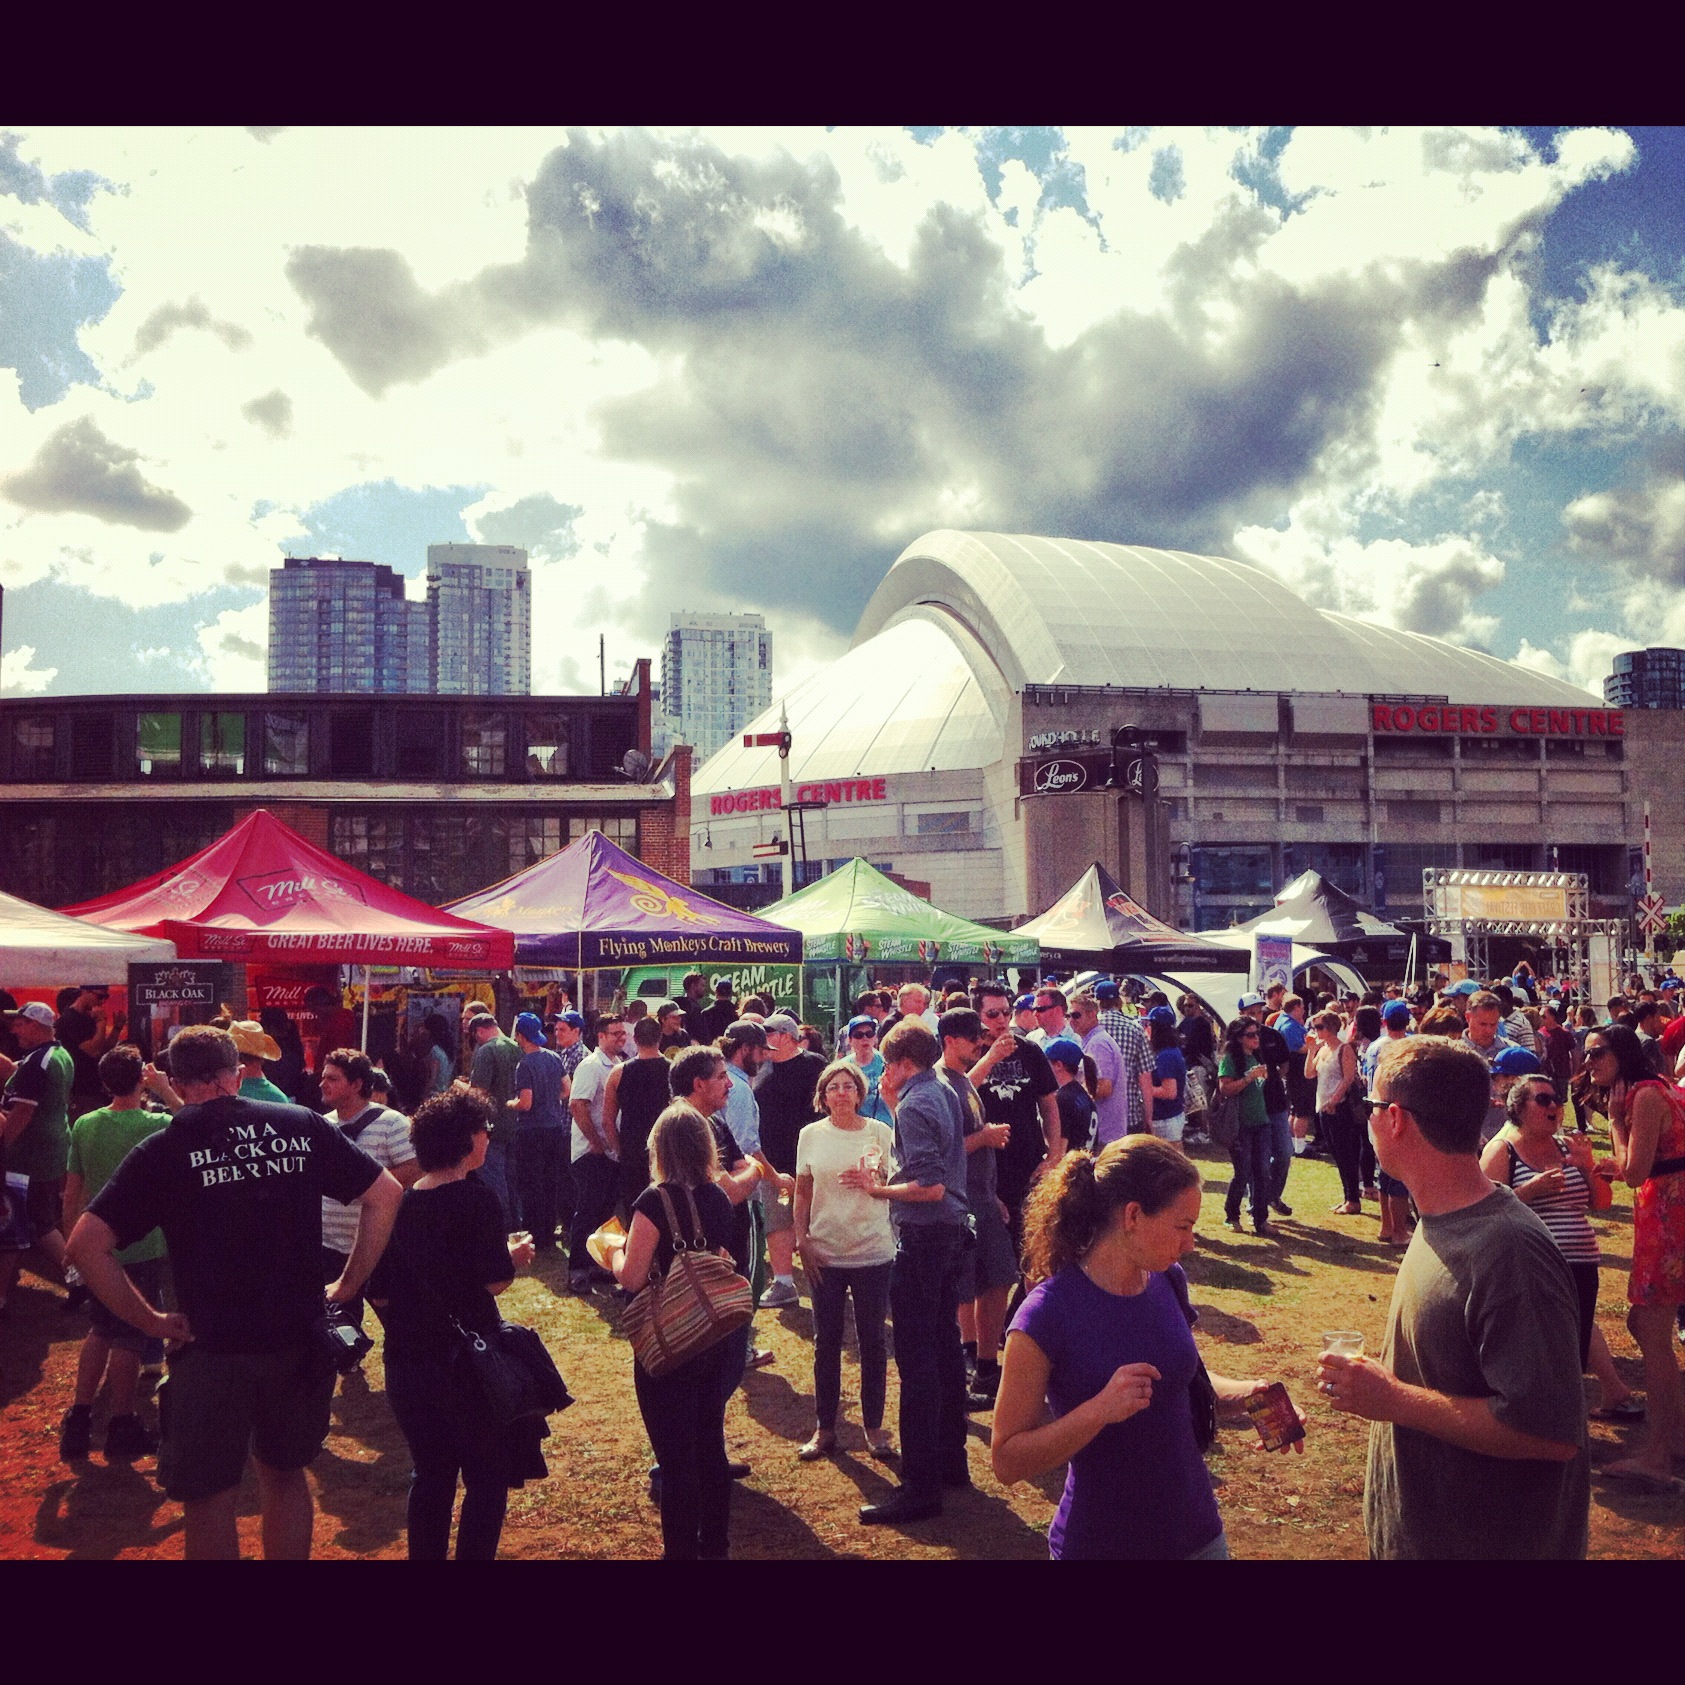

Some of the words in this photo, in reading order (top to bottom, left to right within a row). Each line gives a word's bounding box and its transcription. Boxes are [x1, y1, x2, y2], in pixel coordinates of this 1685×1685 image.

[1372, 705, 1497, 733] ROGERS
[1509, 708, 1625, 736] CENTRE
[1037, 763, 1079, 790] Leon's
[711, 787, 782, 816] ROGERS
[797, 778, 887, 804] CENTRE
[257, 876, 316, 900] Mill
[267, 934, 317, 949] GREAT
[317, 934, 355, 950] BEER
[356, 934, 395, 951] LIVES
[395, 937, 434, 954] HERE.
[599, 937, 647, 959] Flying
[648, 936, 707, 956] Monkeys
[708, 936, 742, 952] Craft
[743, 938, 790, 958] Brewery
[878, 939, 902, 951] STEAM
[145, 989, 179, 999] BLACK
[181, 988, 205, 999] OAK
[263, 986, 302, 1000] Mill
[227, 1124, 257, 1142] 'M
[262, 1122, 278, 1137] A
[271, 1136, 312, 1154] OAK
[201, 1163, 262, 1188] BEER
[265, 1156, 306, 1176] NUT
